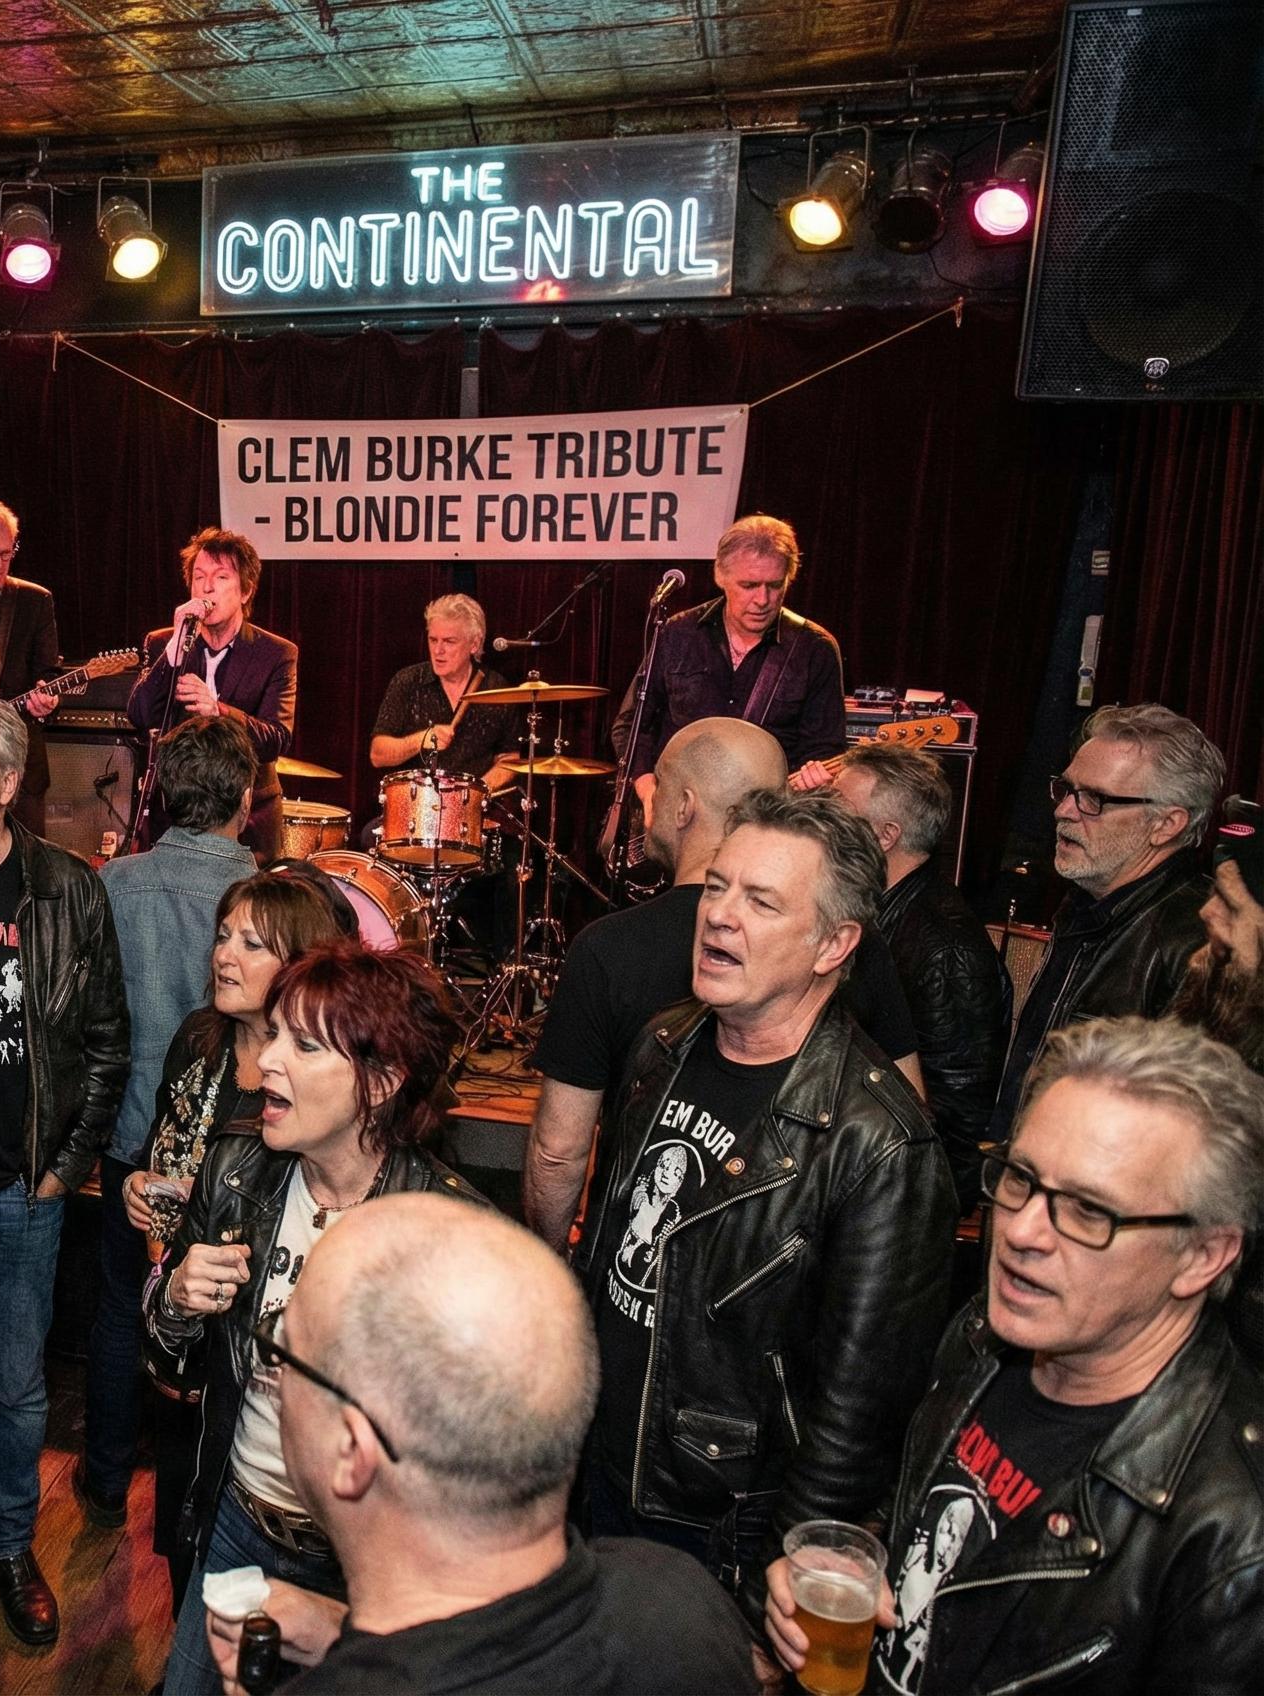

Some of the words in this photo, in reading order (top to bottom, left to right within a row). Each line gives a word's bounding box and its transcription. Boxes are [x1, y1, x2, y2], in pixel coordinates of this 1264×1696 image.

[410, 162, 505, 203] THE
[216, 197, 718, 294] CONTINENTAL
[237, 437, 350, 483] CLEM
[366, 433, 512, 482] BURKE
[528, 425, 725, 479] TRIBUTE
[284, 495, 464, 543] BLONDIE
[476, 491, 678, 542] FOREVER
[660, 1099, 695, 1133] EM
[690, 1111, 736, 1161] BUR
